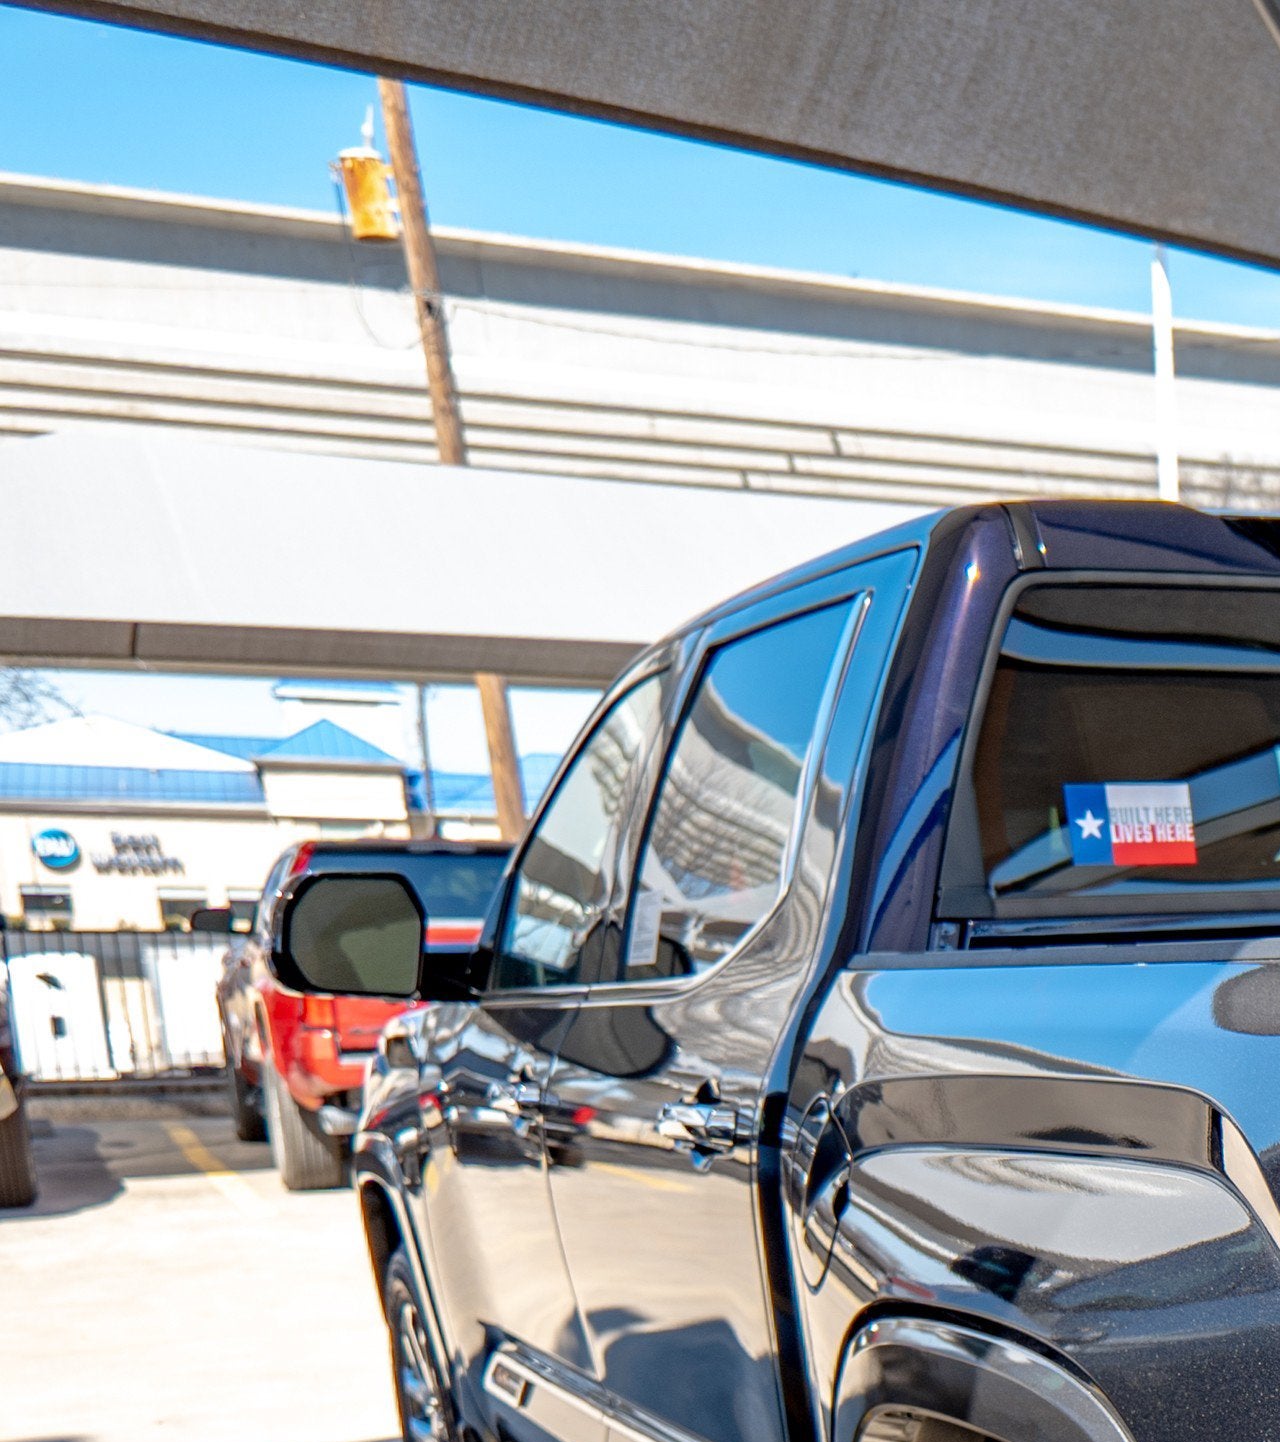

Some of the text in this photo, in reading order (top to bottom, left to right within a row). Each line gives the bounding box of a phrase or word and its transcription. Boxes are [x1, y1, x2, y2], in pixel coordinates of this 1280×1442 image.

[1109, 807, 1192, 825] BUILT HERE
[1111, 824, 1195, 843] LIVES HERE
